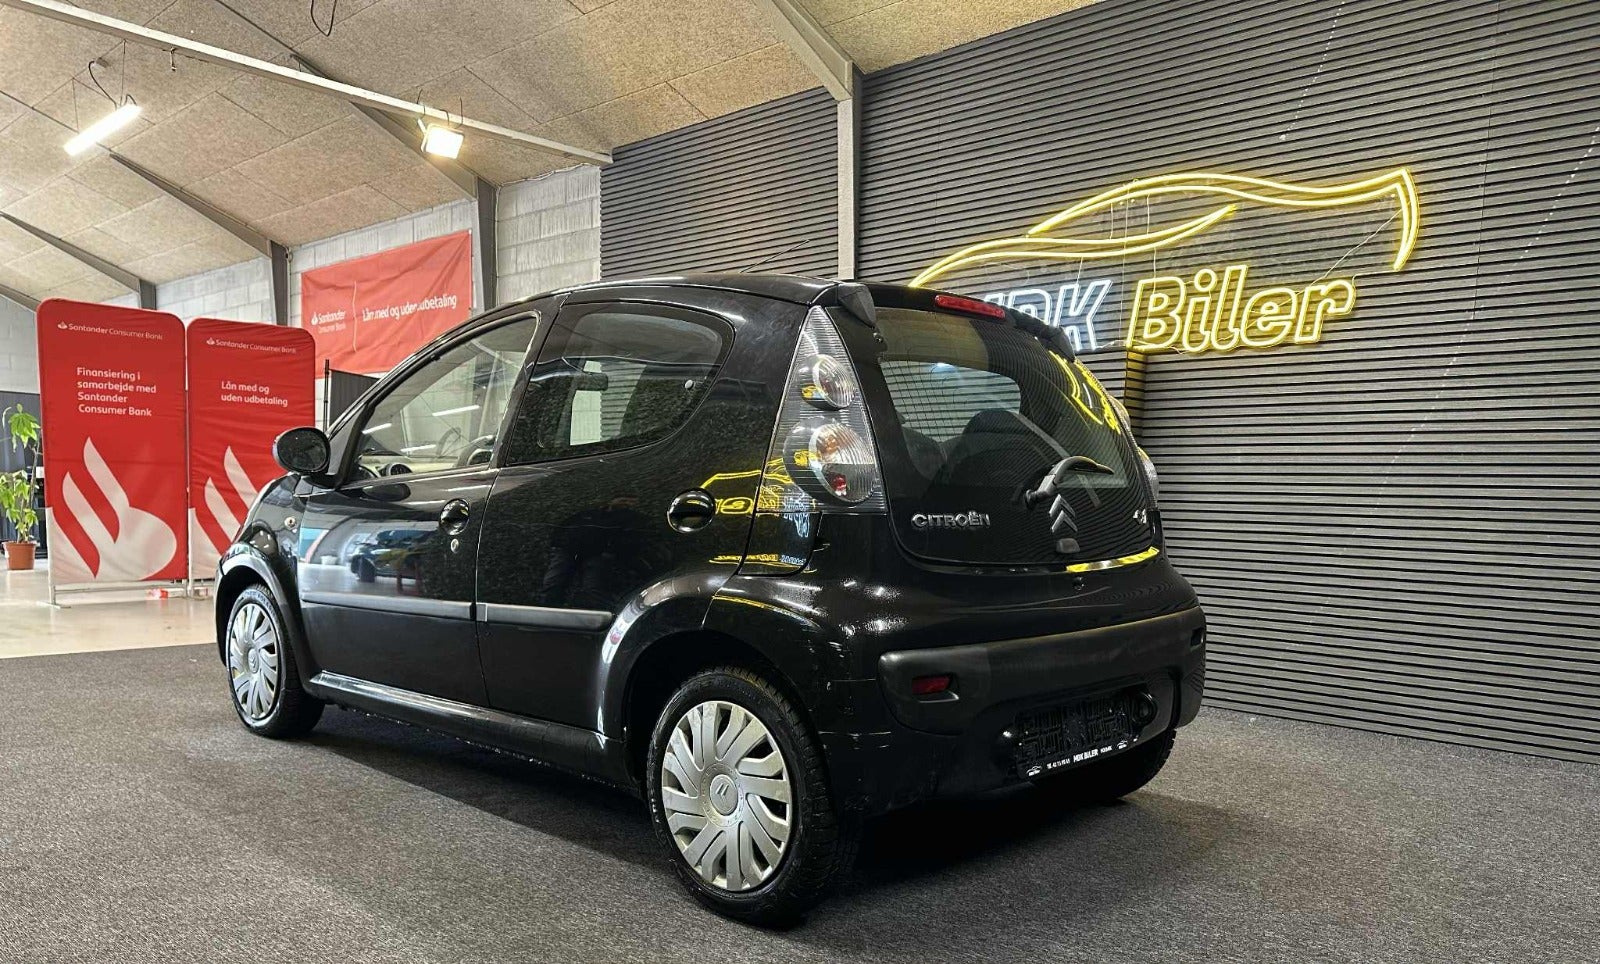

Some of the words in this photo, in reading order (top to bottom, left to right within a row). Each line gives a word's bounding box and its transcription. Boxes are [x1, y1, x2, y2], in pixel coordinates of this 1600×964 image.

[390, 306, 400, 320] og
[1125, 265, 1356, 354] Biler
[68, 323, 108, 335] Santander
[108, 328, 144, 339] Consumer
[145, 332, 163, 340] Bank
[215, 339, 249, 349] Santander
[249, 343, 280, 353] Consumer
[76, 367, 136, 382] Finansiering
[137, 371, 141, 380] i
[76, 380, 134, 393] samarbejde
[136, 384, 157, 394] med
[221, 380, 237, 391] Lån
[238, 383, 257, 392] med
[258, 385, 270, 395] og
[77, 391, 128, 403] Santander
[221, 393, 243, 403] uden
[244, 394, 288, 408] udbetaling
[78, 404, 126, 415] Consumer
[128, 406, 152, 417] Bank
[911, 511, 991, 528] CITROËN
